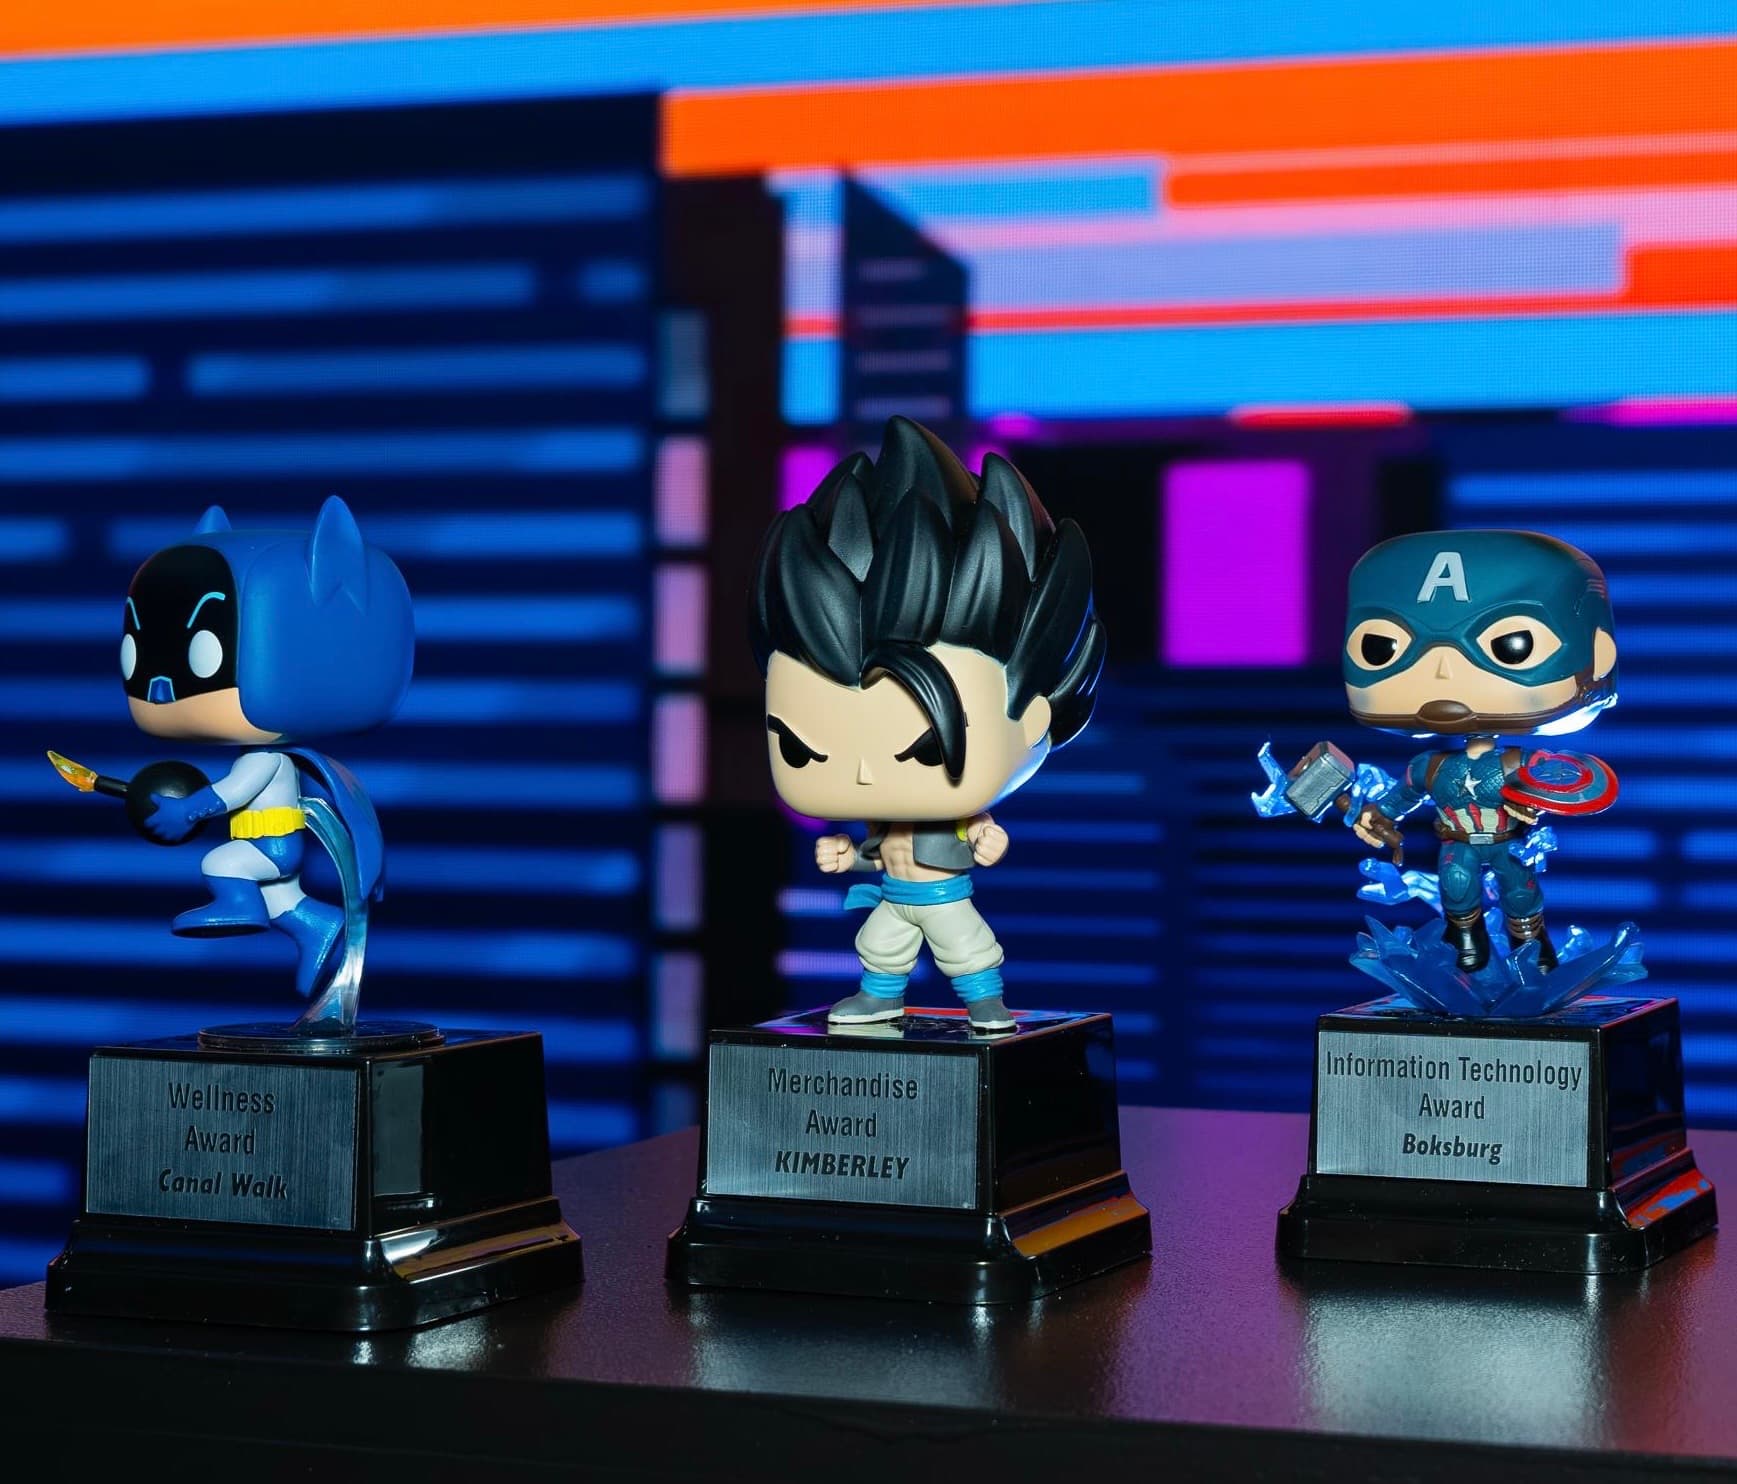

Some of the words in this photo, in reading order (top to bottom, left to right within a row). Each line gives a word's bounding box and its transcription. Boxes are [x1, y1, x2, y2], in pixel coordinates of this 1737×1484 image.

[1416, 551, 1471, 603] A
[767, 1067, 918, 1100] Merchandise
[1326, 1050, 1450, 1081] Information
[1458, 1056, 1583, 1091] Technology
[167, 1082, 276, 1115] Wellness
[1418, 1092, 1486, 1120] Award
[184, 1124, 256, 1155] Award
[805, 1109, 878, 1138] Award
[774, 1149, 910, 1180] KIMBERLEY
[1402, 1132, 1503, 1166] Boksburg
[158, 1168, 222, 1195] Canal
[231, 1171, 288, 1200] Walk
